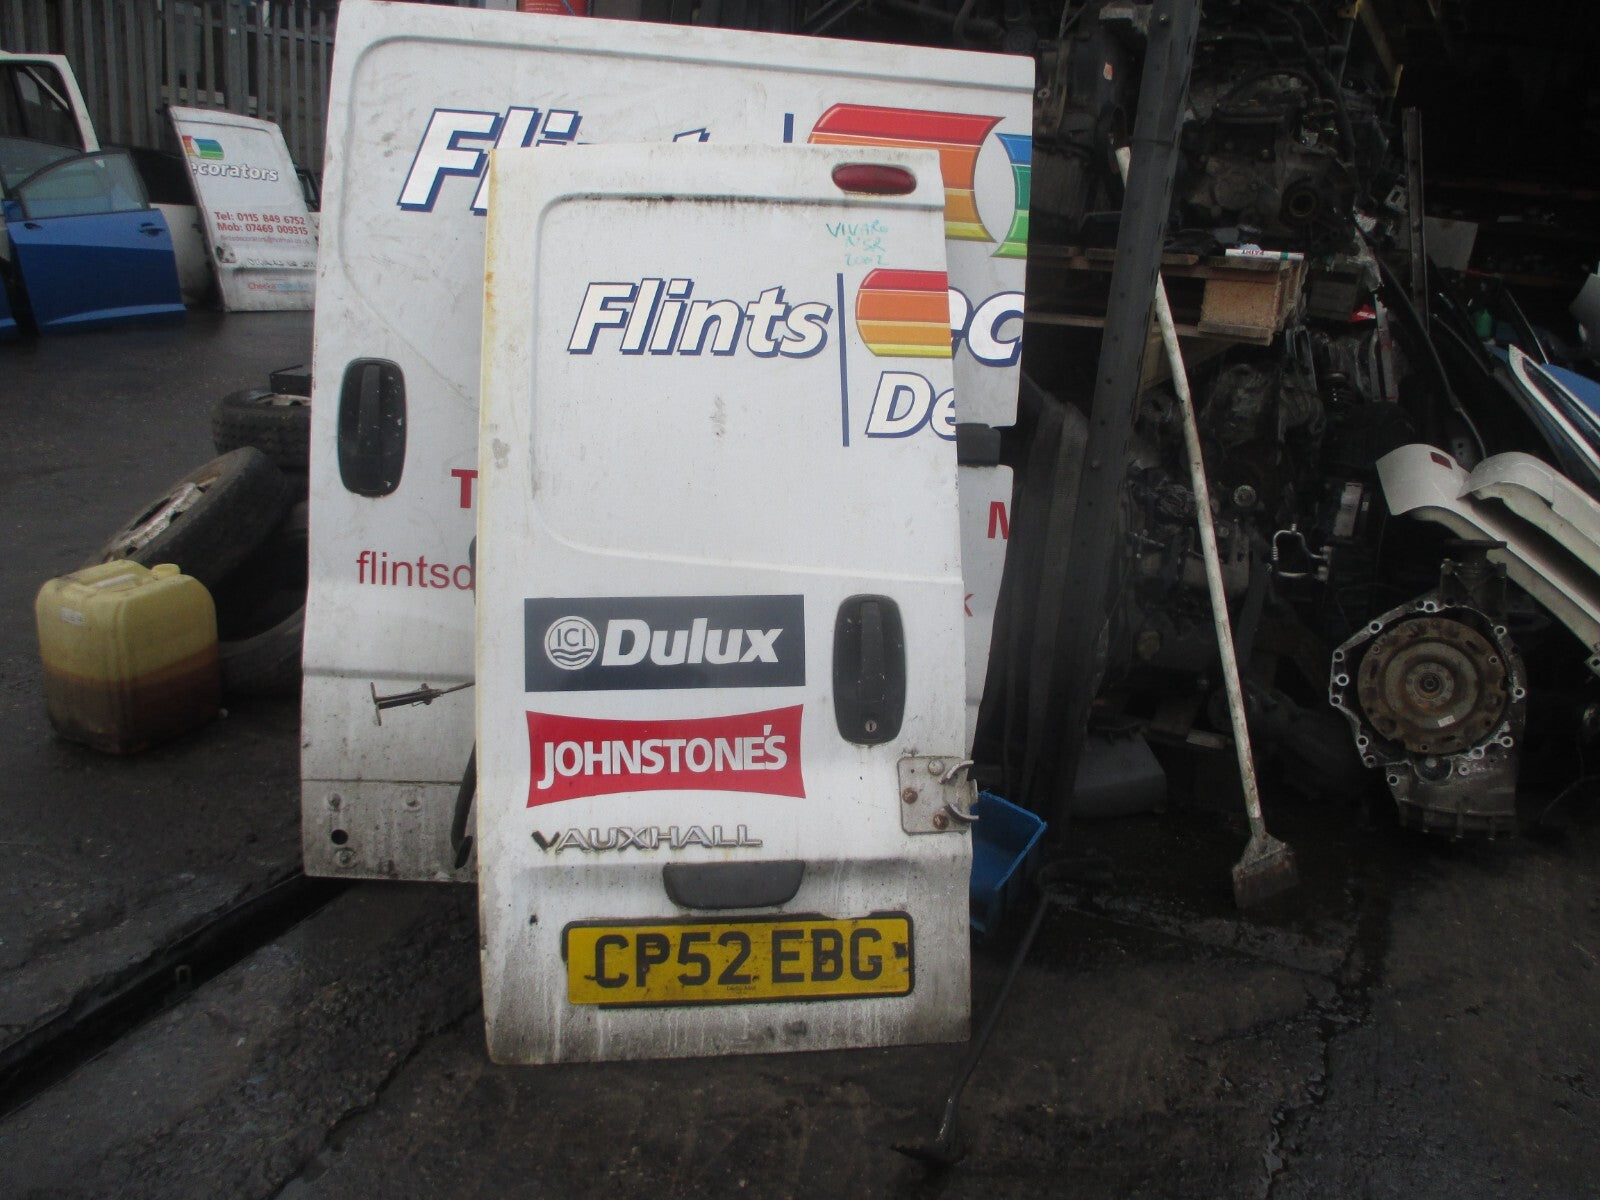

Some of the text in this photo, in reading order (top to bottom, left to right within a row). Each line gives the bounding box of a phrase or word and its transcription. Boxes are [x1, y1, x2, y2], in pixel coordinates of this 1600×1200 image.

[214, 211, 306, 225] Tel: 0115 849 6752
[216, 222, 309, 235] Mob: 07469 009315
[567, 277, 834, 359] Flints
[556, 617, 784, 667] ICI Dulux
[536, 724, 788, 790] JOHNSTONE'S
[531, 824, 763, 854] VAUXHALL
[594, 927, 884, 989] CP52 EBG
